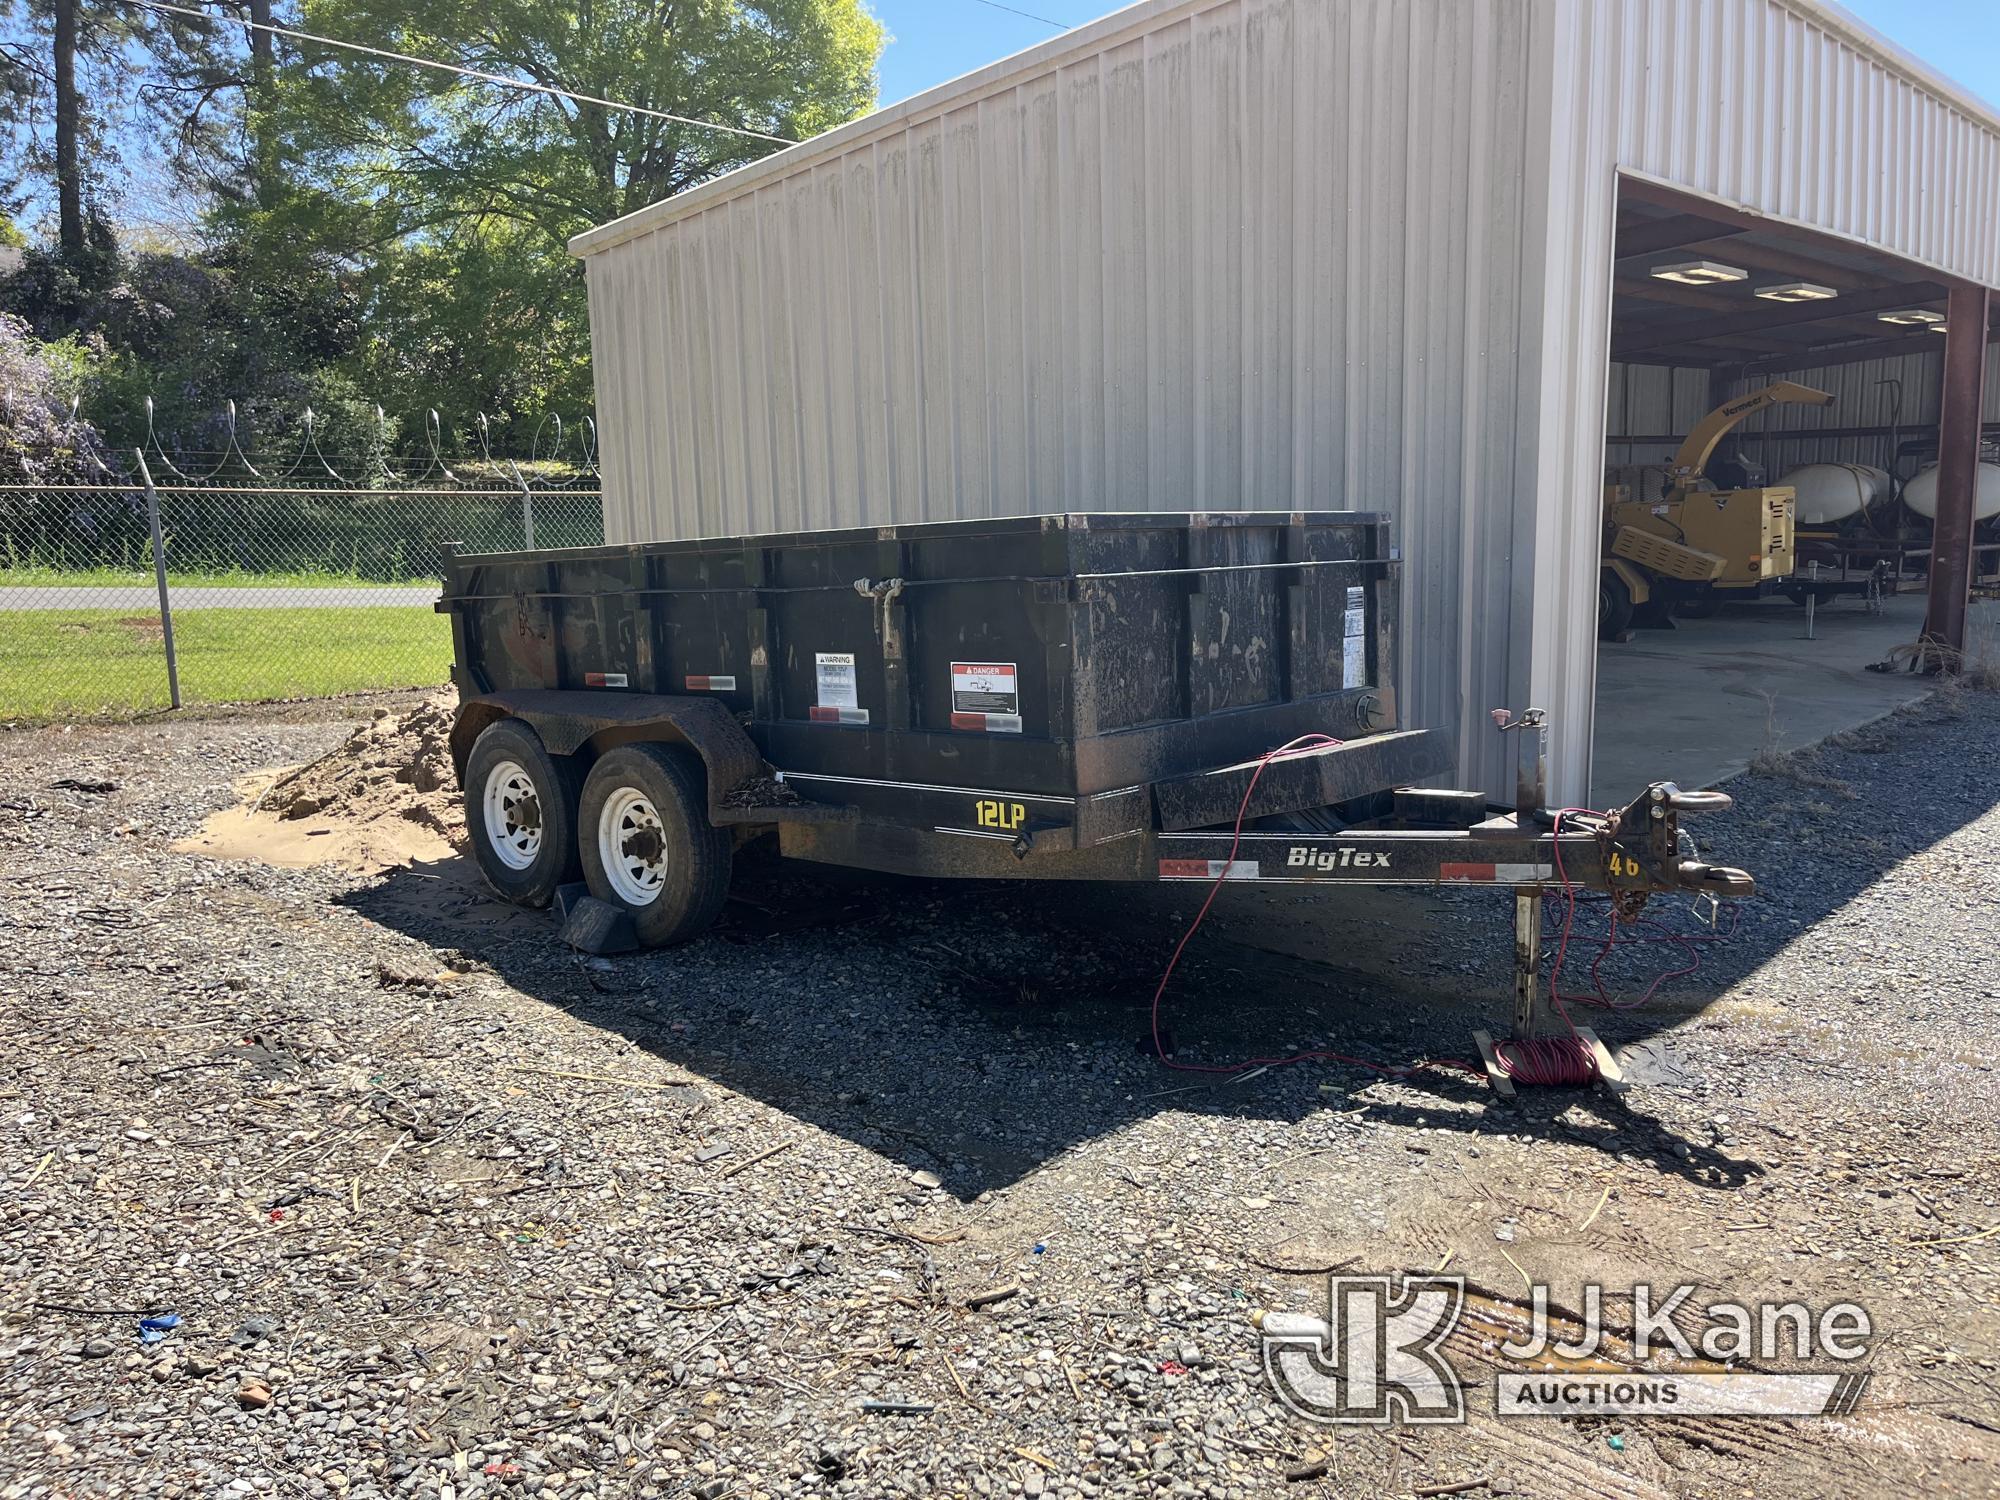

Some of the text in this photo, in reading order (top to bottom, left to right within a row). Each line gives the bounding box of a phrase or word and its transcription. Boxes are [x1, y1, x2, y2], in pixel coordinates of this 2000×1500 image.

[1722, 396, 1762, 416] Vermeer
[824, 656, 850, 664] WARNING
[975, 800, 1025, 829] 12LP
[1286, 847, 1392, 871] BigTex
